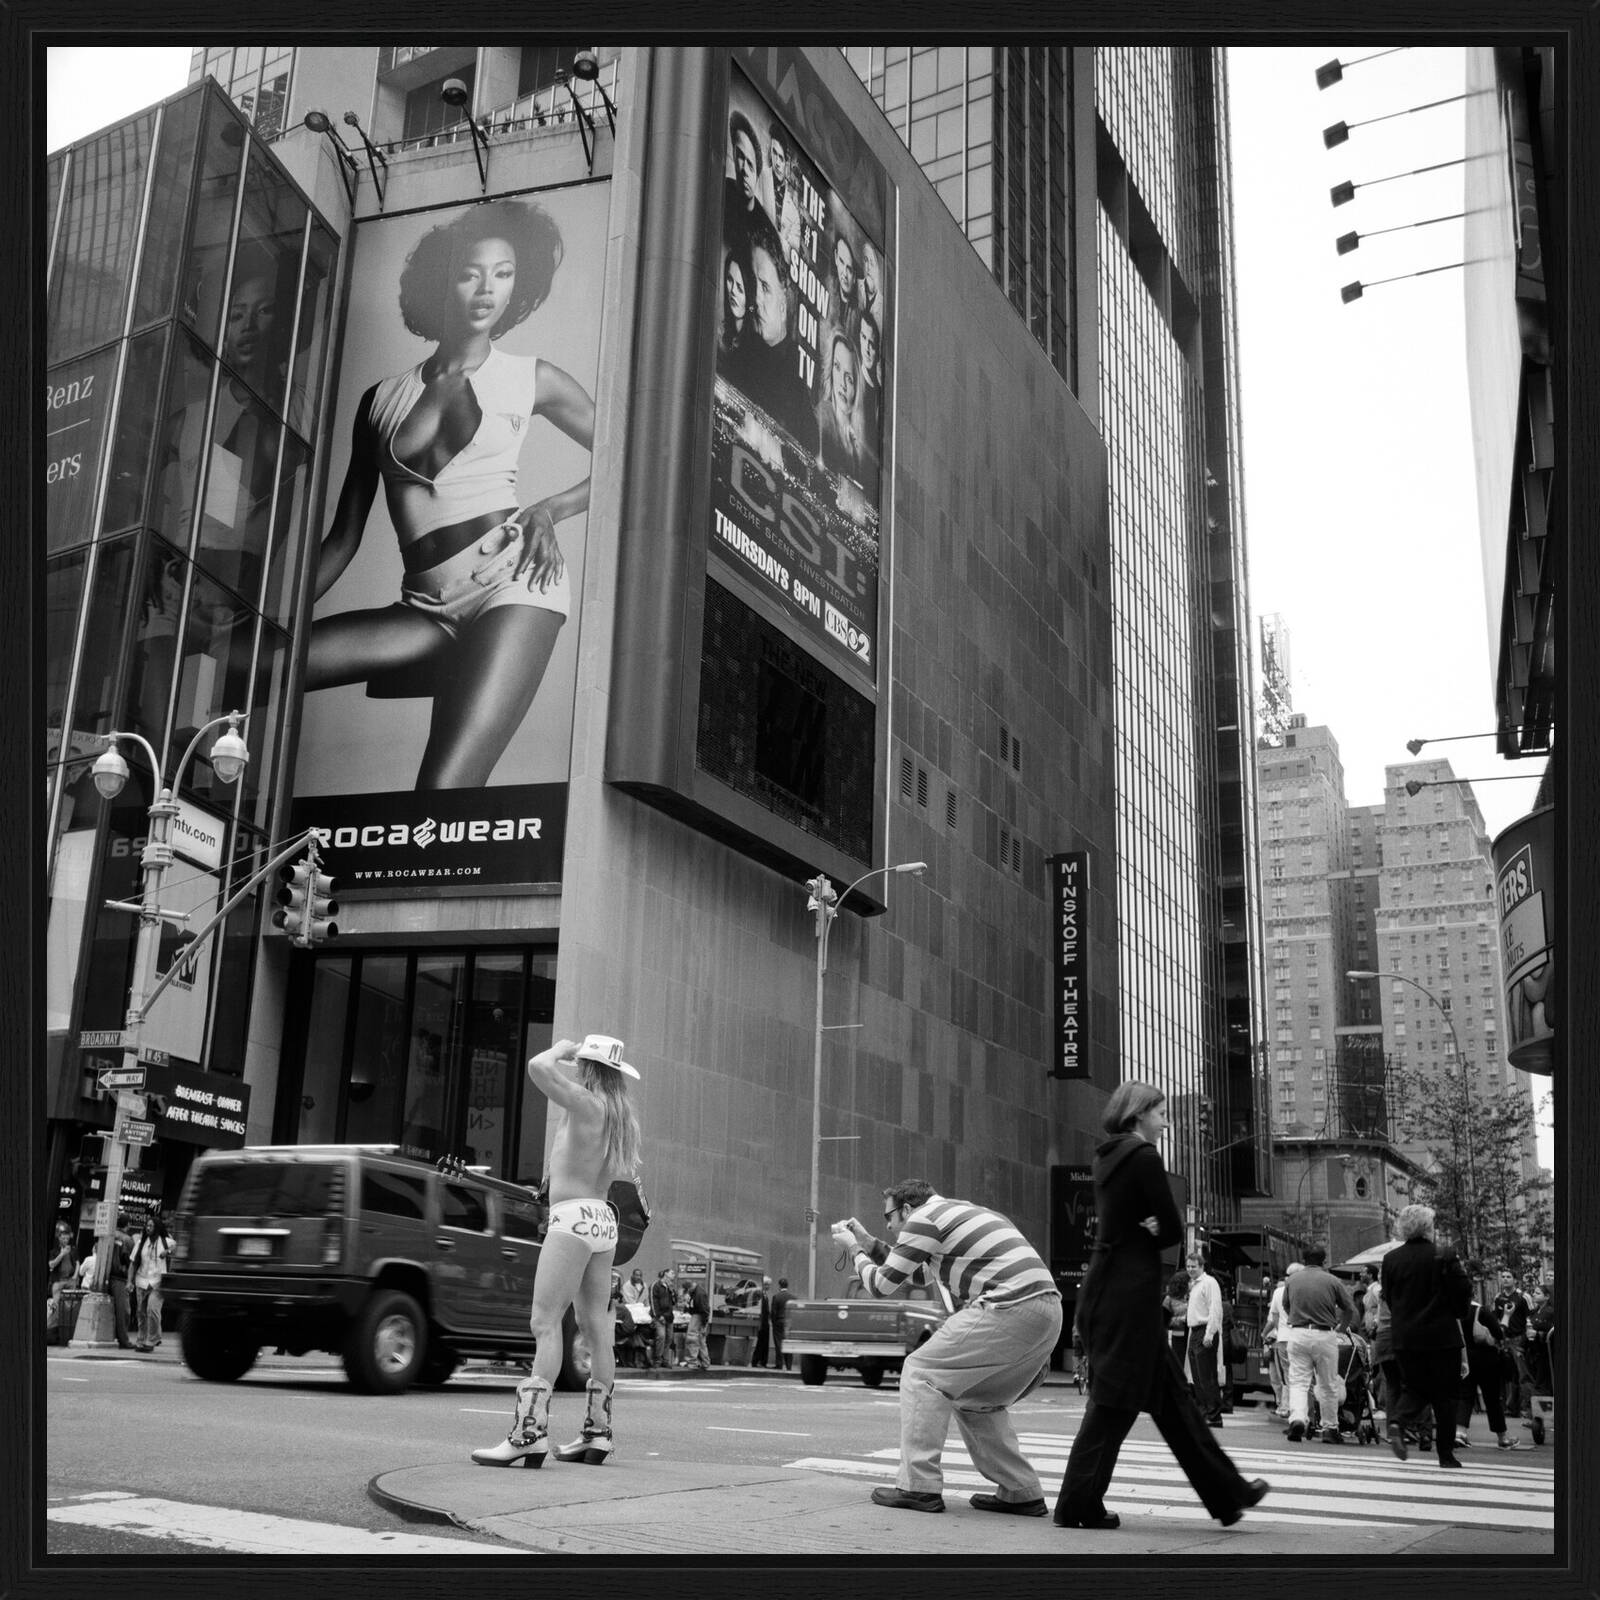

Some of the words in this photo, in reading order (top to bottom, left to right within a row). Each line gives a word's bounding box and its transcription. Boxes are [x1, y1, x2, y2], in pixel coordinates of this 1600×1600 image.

[801, 174, 826, 231] THE
[804, 225, 819, 264] #1
[790, 248, 830, 319] SHOW
[798, 303, 818, 351] ON
[798, 345, 816, 390] TV
[729, 494, 761, 529] CRIME
[765, 527, 796, 561] SCENE
[715, 508, 790, 590] THURSDAYS
[793, 579, 821, 619] 9PM
[826, 606, 848, 640] CBS
[799, 557, 866, 620] INVESTIGATION
[355, 867, 482, 879] WWW.ROCAWEAR.COM
[1061, 861, 1078, 966] MINSKOFF
[80, 1032, 119, 1046] BROADWAY
[1063, 976, 1078, 1067] THEATRE
[104, 1074, 118, 1084] ONE
[125, 1072, 140, 1083] WAY
[152, 1050, 162, 1064] 45
